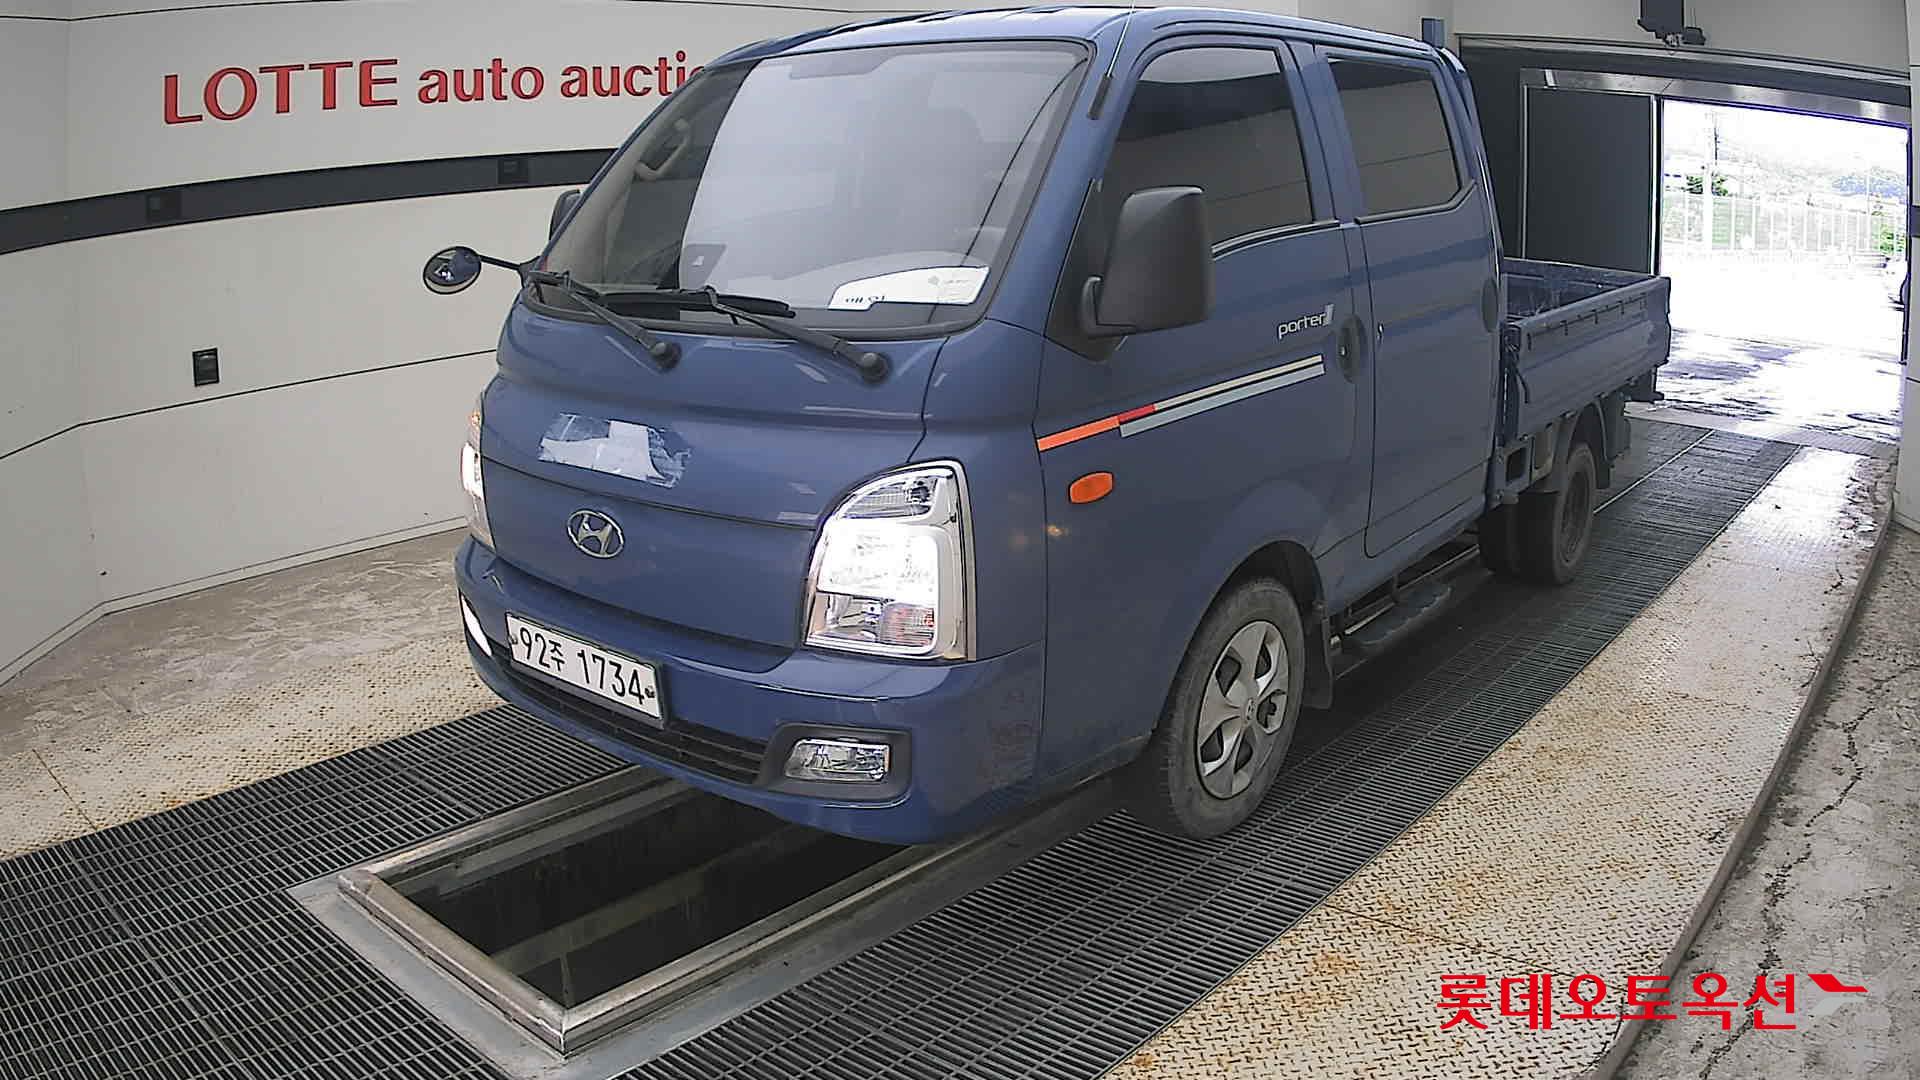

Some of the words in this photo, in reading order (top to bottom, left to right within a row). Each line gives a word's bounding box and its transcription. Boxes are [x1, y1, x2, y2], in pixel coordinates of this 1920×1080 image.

[163, 58, 399, 125] LOTTE
[417, 57, 545, 104] auto
[519, 627, 565, 672] 92주
[577, 649, 645, 705] 1734
